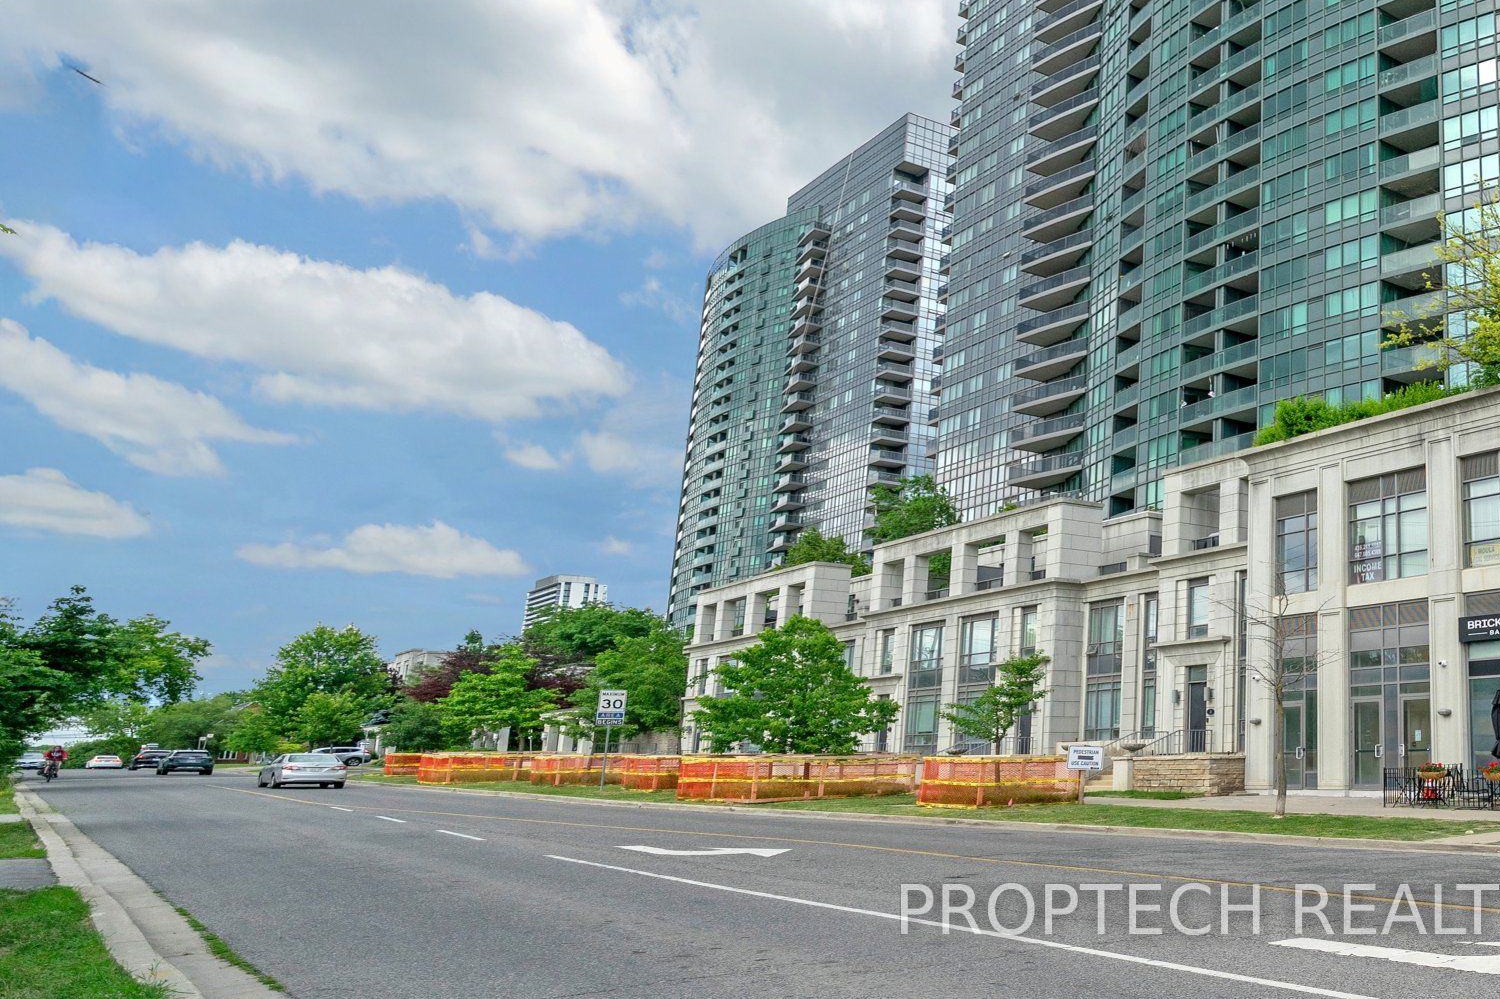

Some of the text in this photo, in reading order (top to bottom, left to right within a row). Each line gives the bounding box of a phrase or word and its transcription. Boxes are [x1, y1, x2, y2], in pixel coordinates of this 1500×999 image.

[1354, 561, 1382, 574] INCOME
[1361, 572, 1375, 582] TAX
[601, 699, 623, 709] 30
